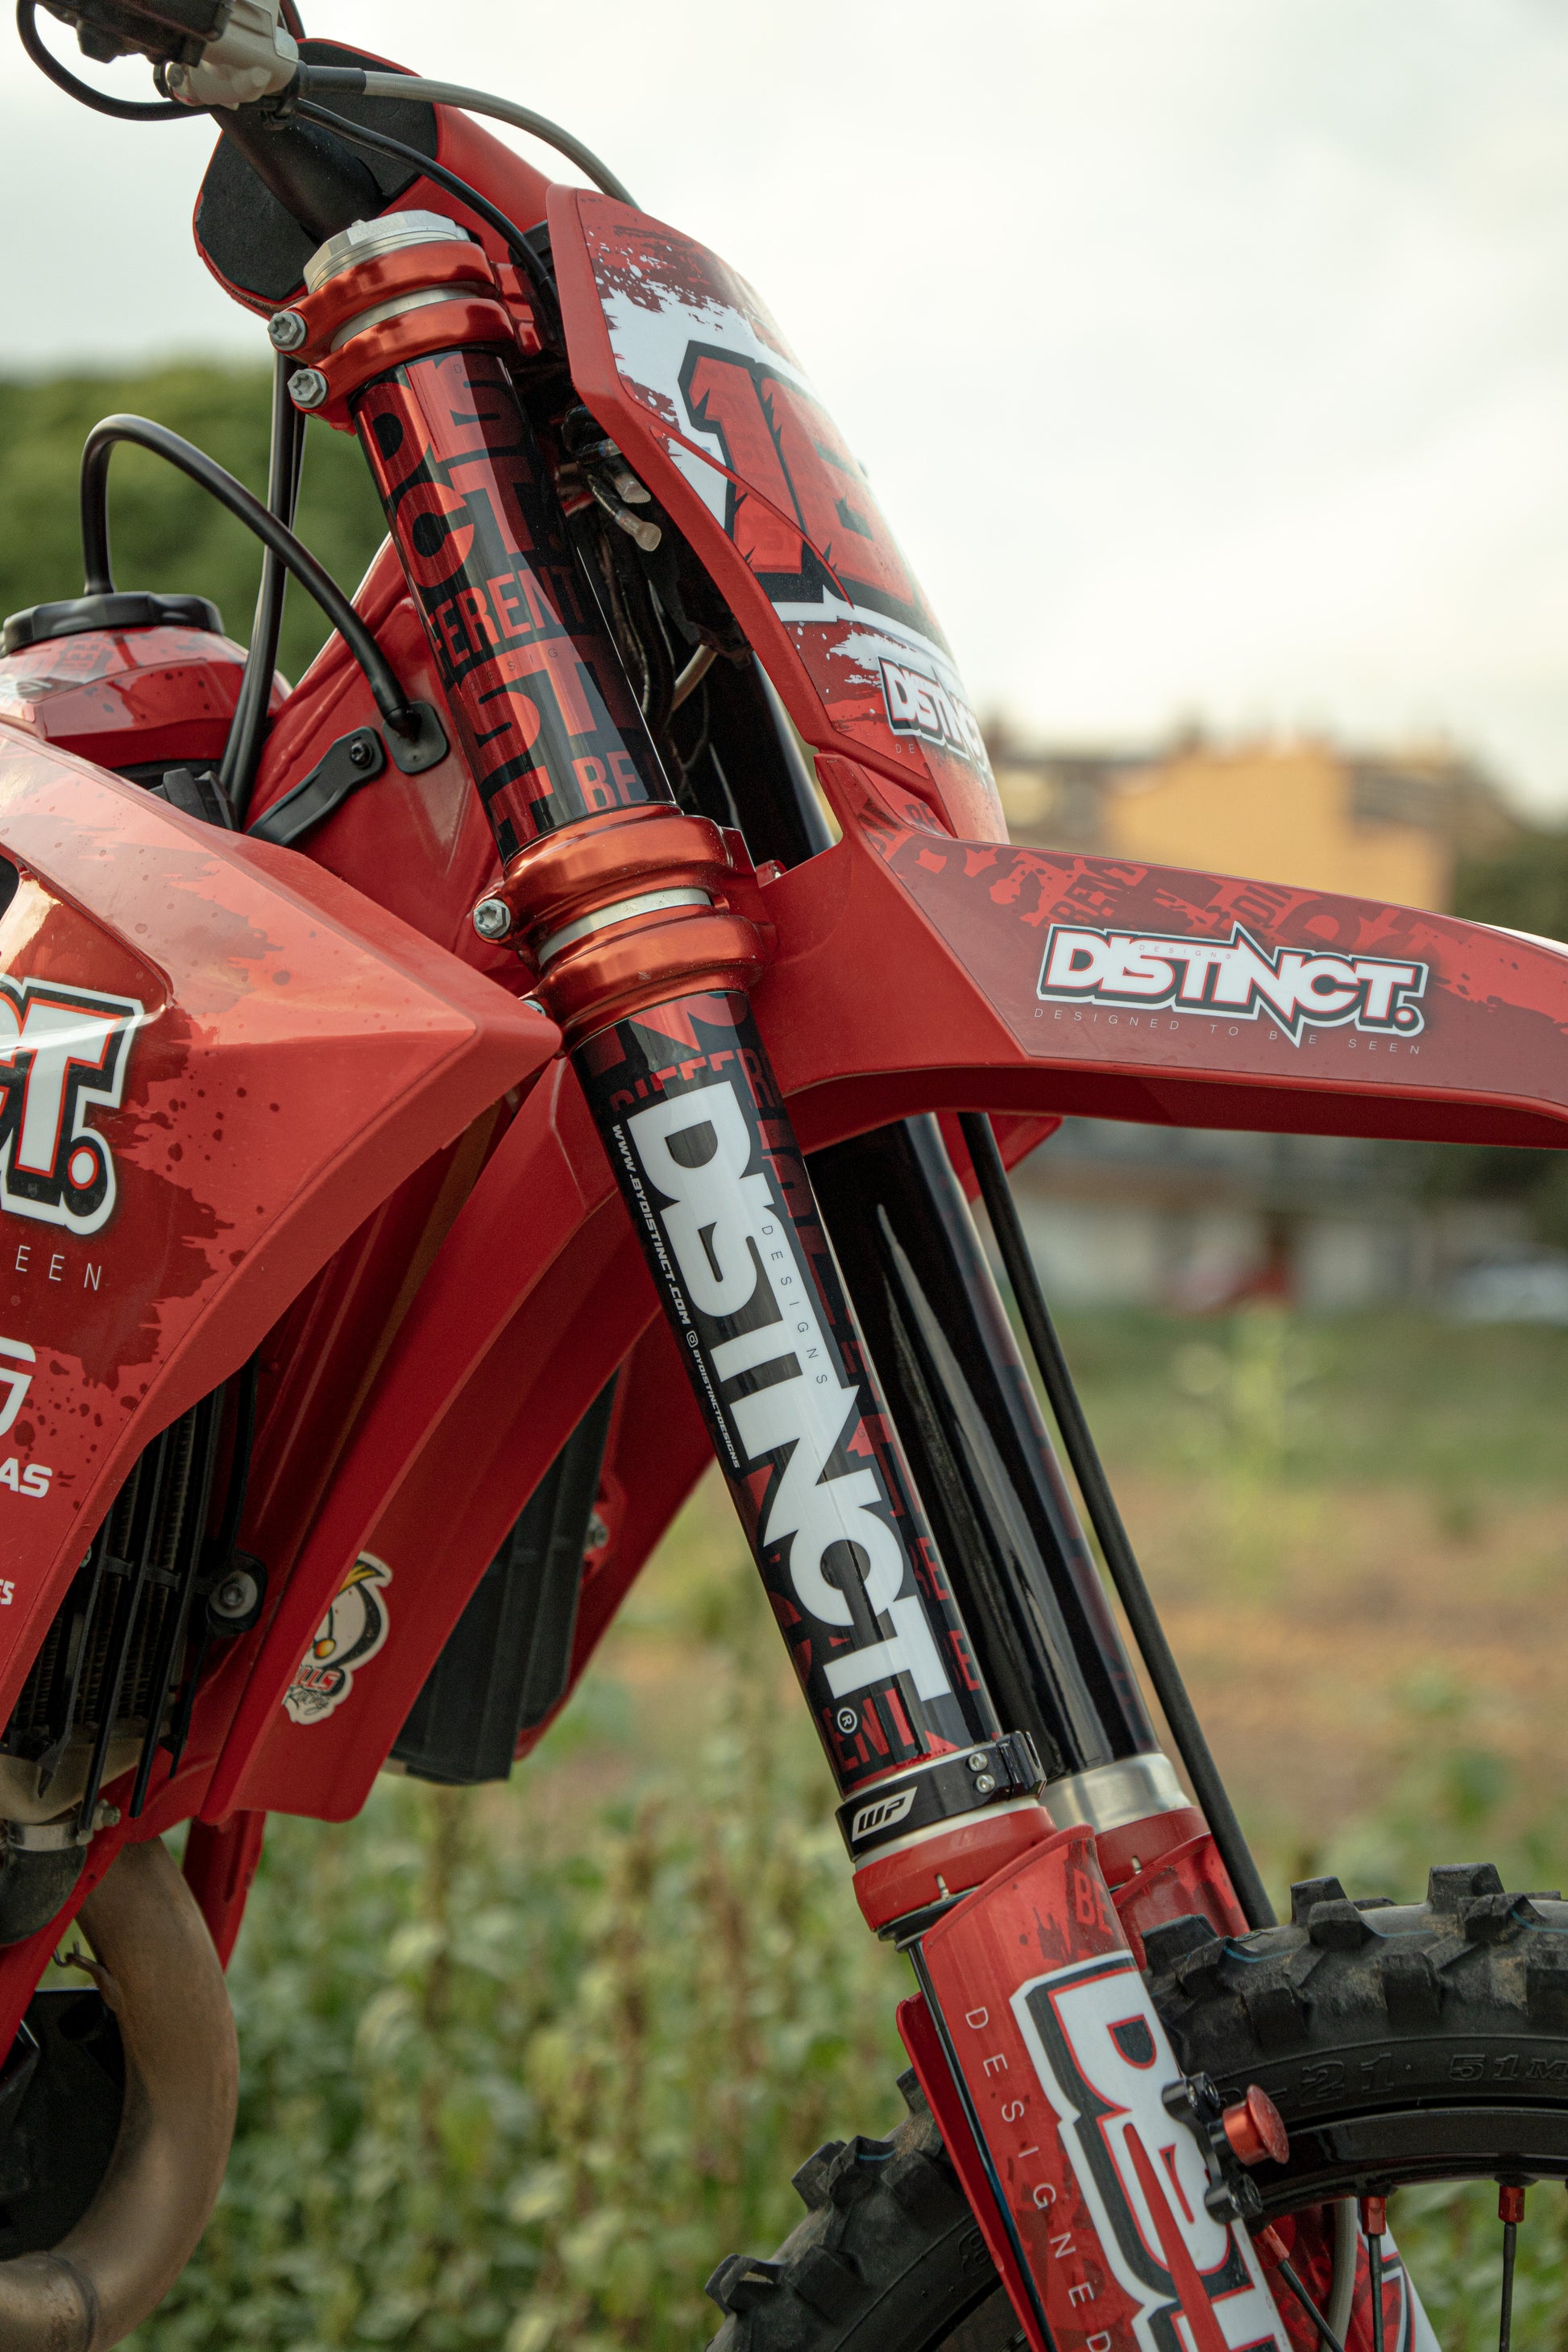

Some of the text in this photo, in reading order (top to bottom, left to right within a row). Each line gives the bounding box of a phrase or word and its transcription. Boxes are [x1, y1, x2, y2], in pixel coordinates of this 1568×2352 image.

[1139, 944, 1232, 961] DESIGNS
[1033, 1007, 1421, 1056] DESIGNED TO BE SEEN
[761, 1223, 829, 1385] DESIGNS
[627, 1080, 952, 1703] DISTINCT
